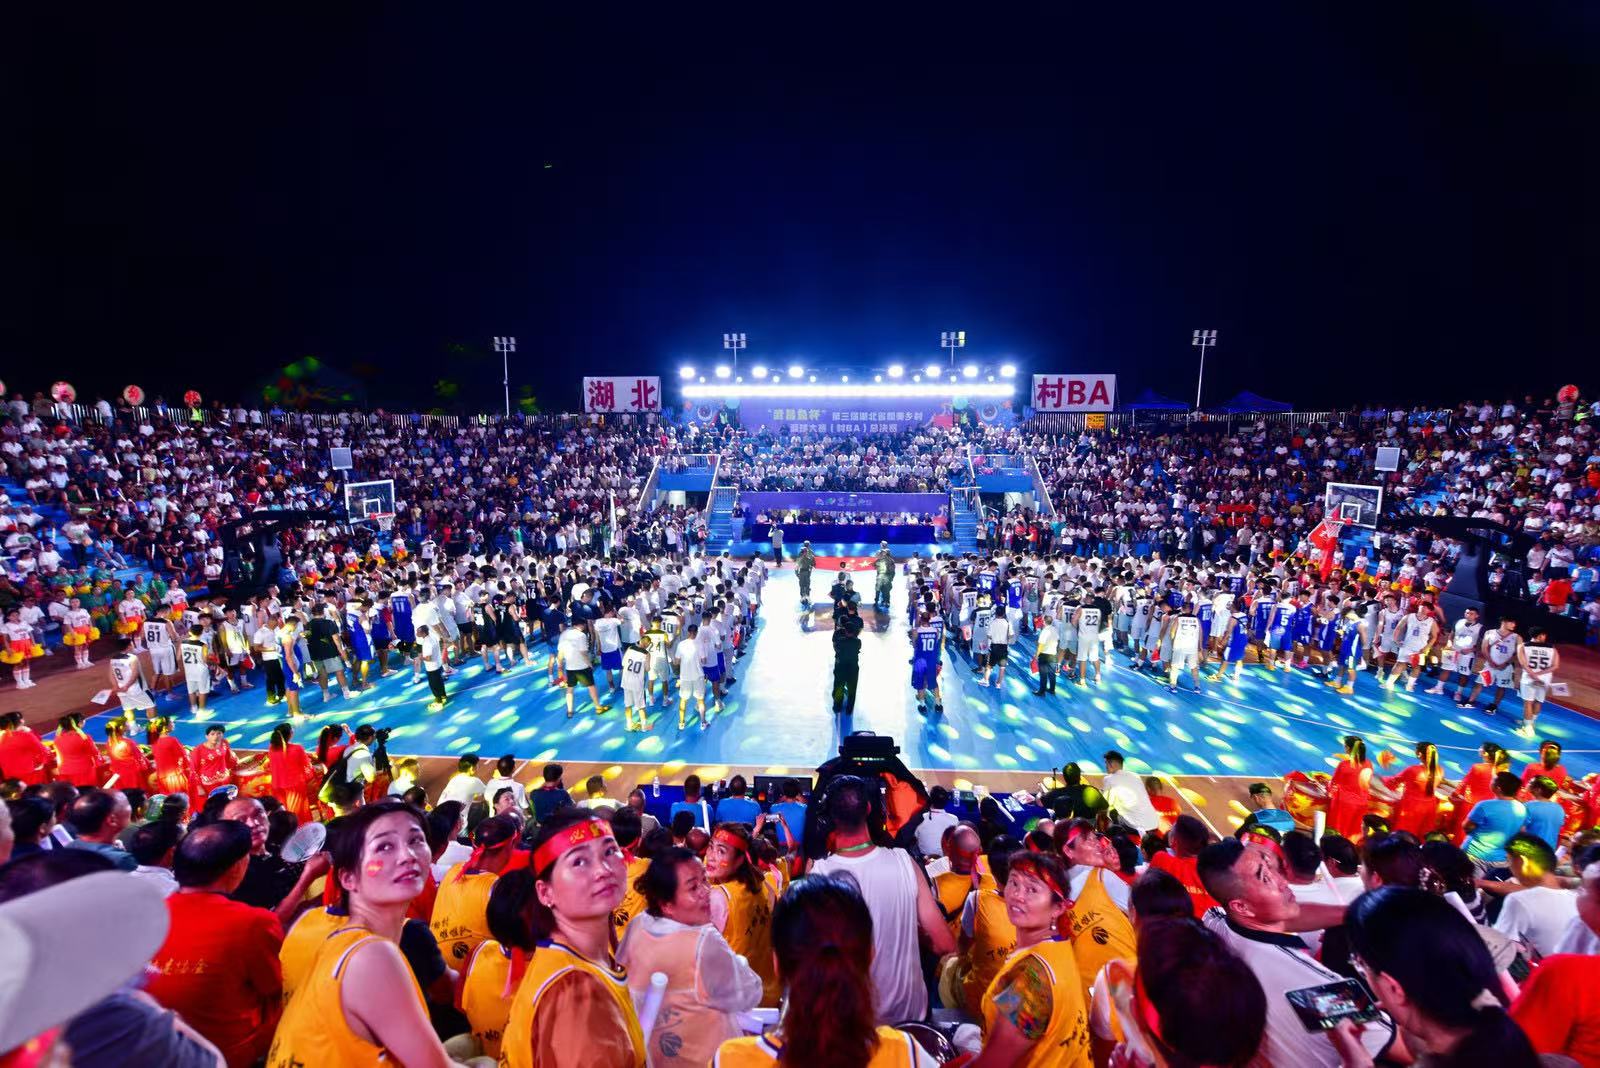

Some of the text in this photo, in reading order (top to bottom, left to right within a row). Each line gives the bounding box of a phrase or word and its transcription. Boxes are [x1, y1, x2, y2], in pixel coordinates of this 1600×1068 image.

[589, 380, 658, 409] 湖北
[1037, 378, 1110, 408] 村BA
[395, 601, 405, 613] 11
[1085, 614, 1098, 626] 22
[1280, 615, 1289, 626] 5
[662, 621, 674, 634] 10
[147, 630, 161, 643] 81
[921, 639, 935, 652] 10
[184, 651, 198, 664] 21
[1529, 656, 1550, 670] 55
[627, 658, 642, 674] 20
